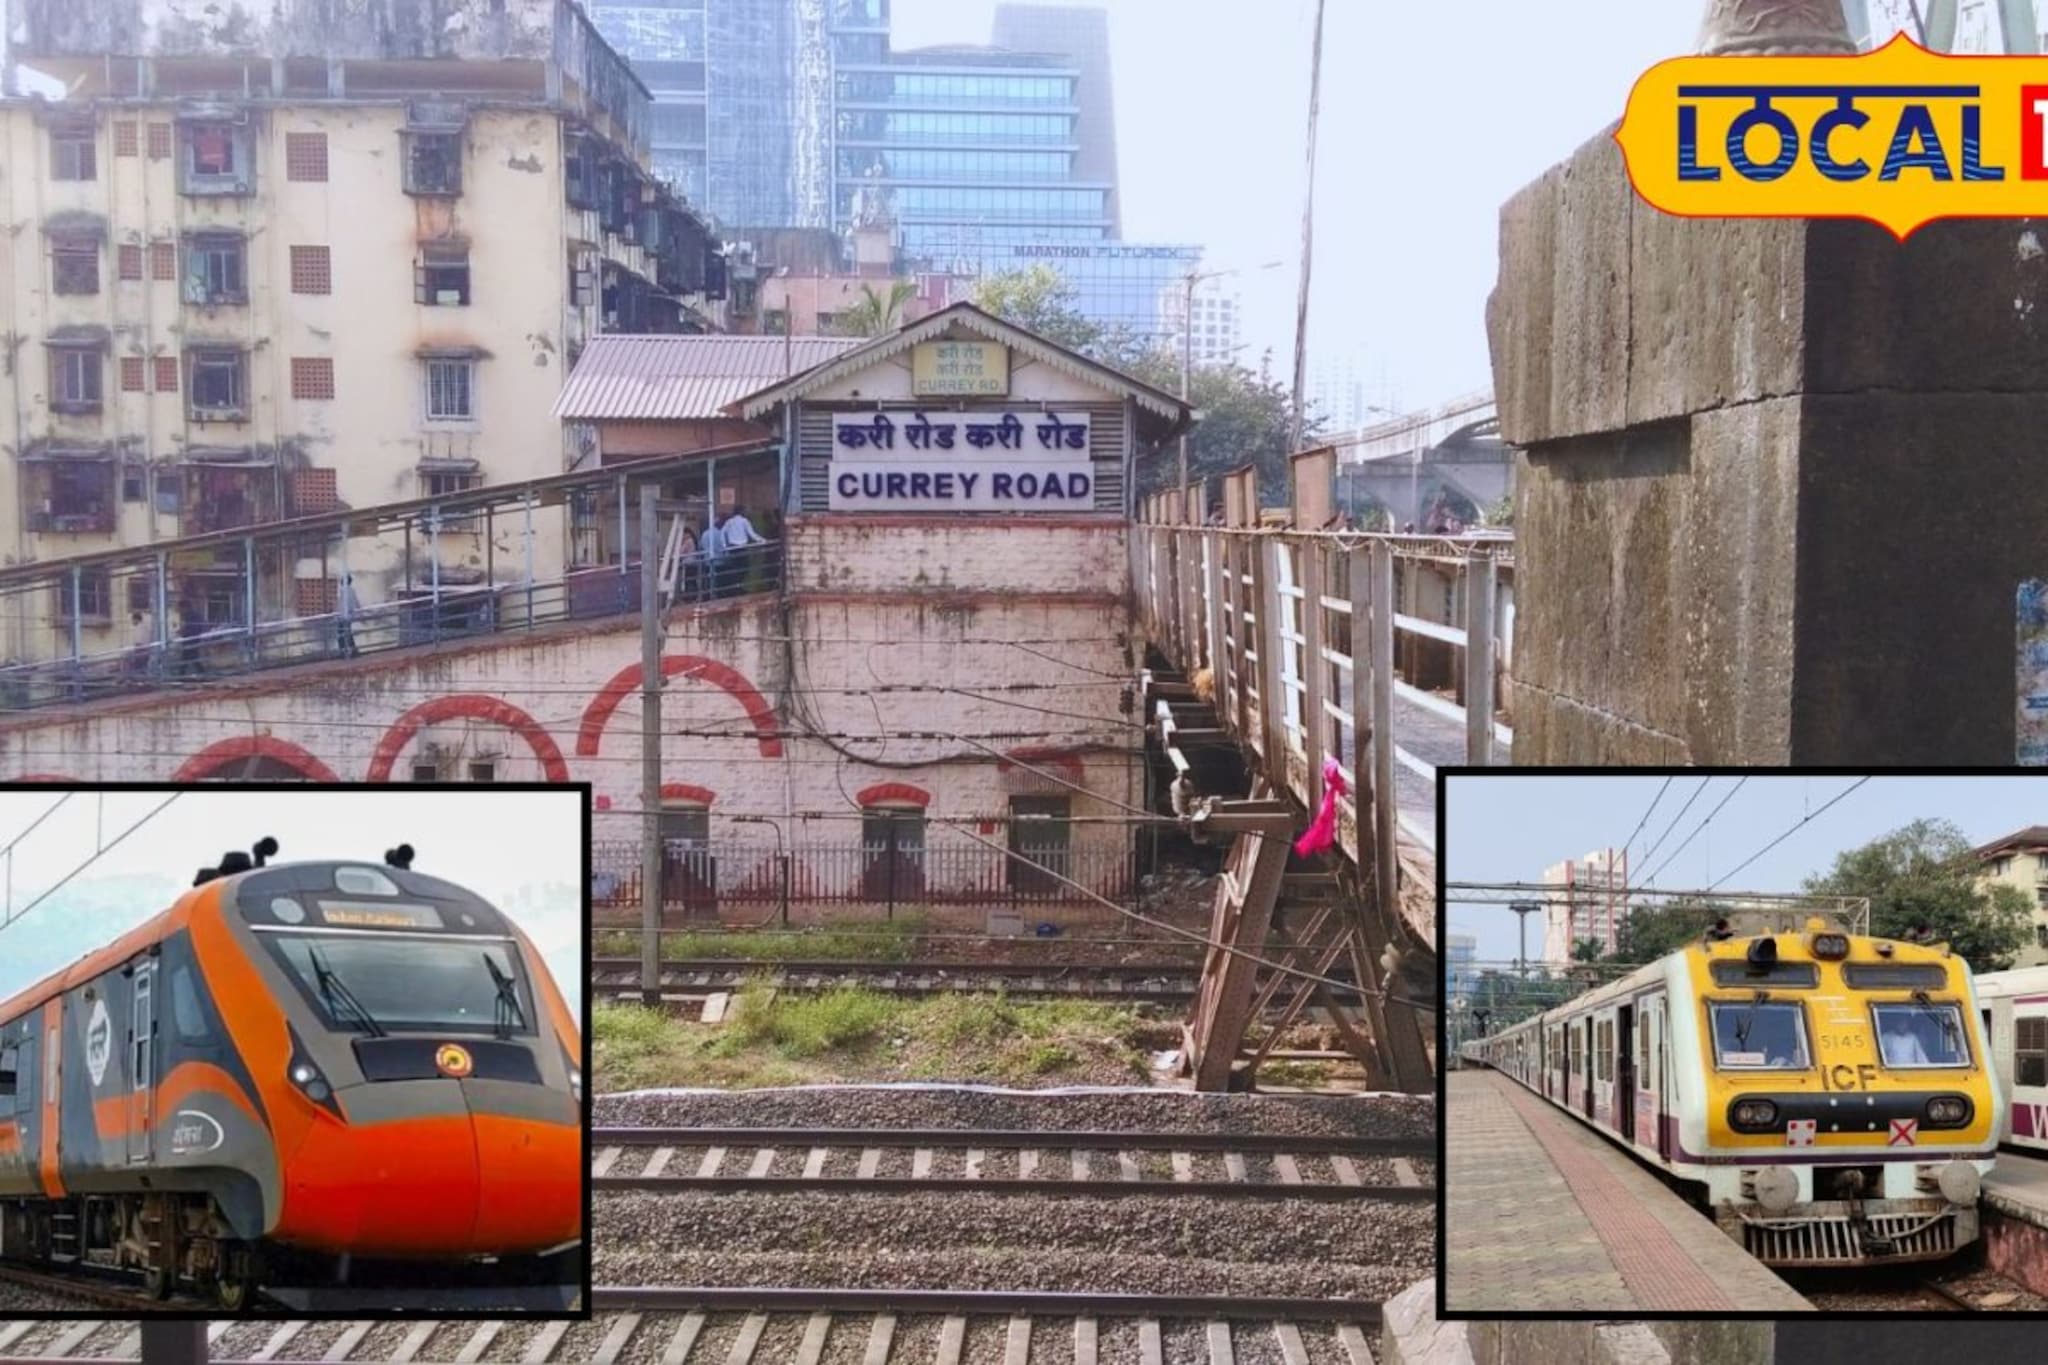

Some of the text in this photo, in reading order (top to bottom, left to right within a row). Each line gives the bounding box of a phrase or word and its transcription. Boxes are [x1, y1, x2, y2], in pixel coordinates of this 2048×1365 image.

[1014, 245, 1090, 258] MARATHON
[919, 379, 975, 391] CURREY
[837, 412, 1088, 449] करी रोड करी रोड
[837, 473, 1091, 499] CURREY ROAD
[1821, 1034, 1865, 1049] 5145
[1822, 1064, 1877, 1091] ICF
